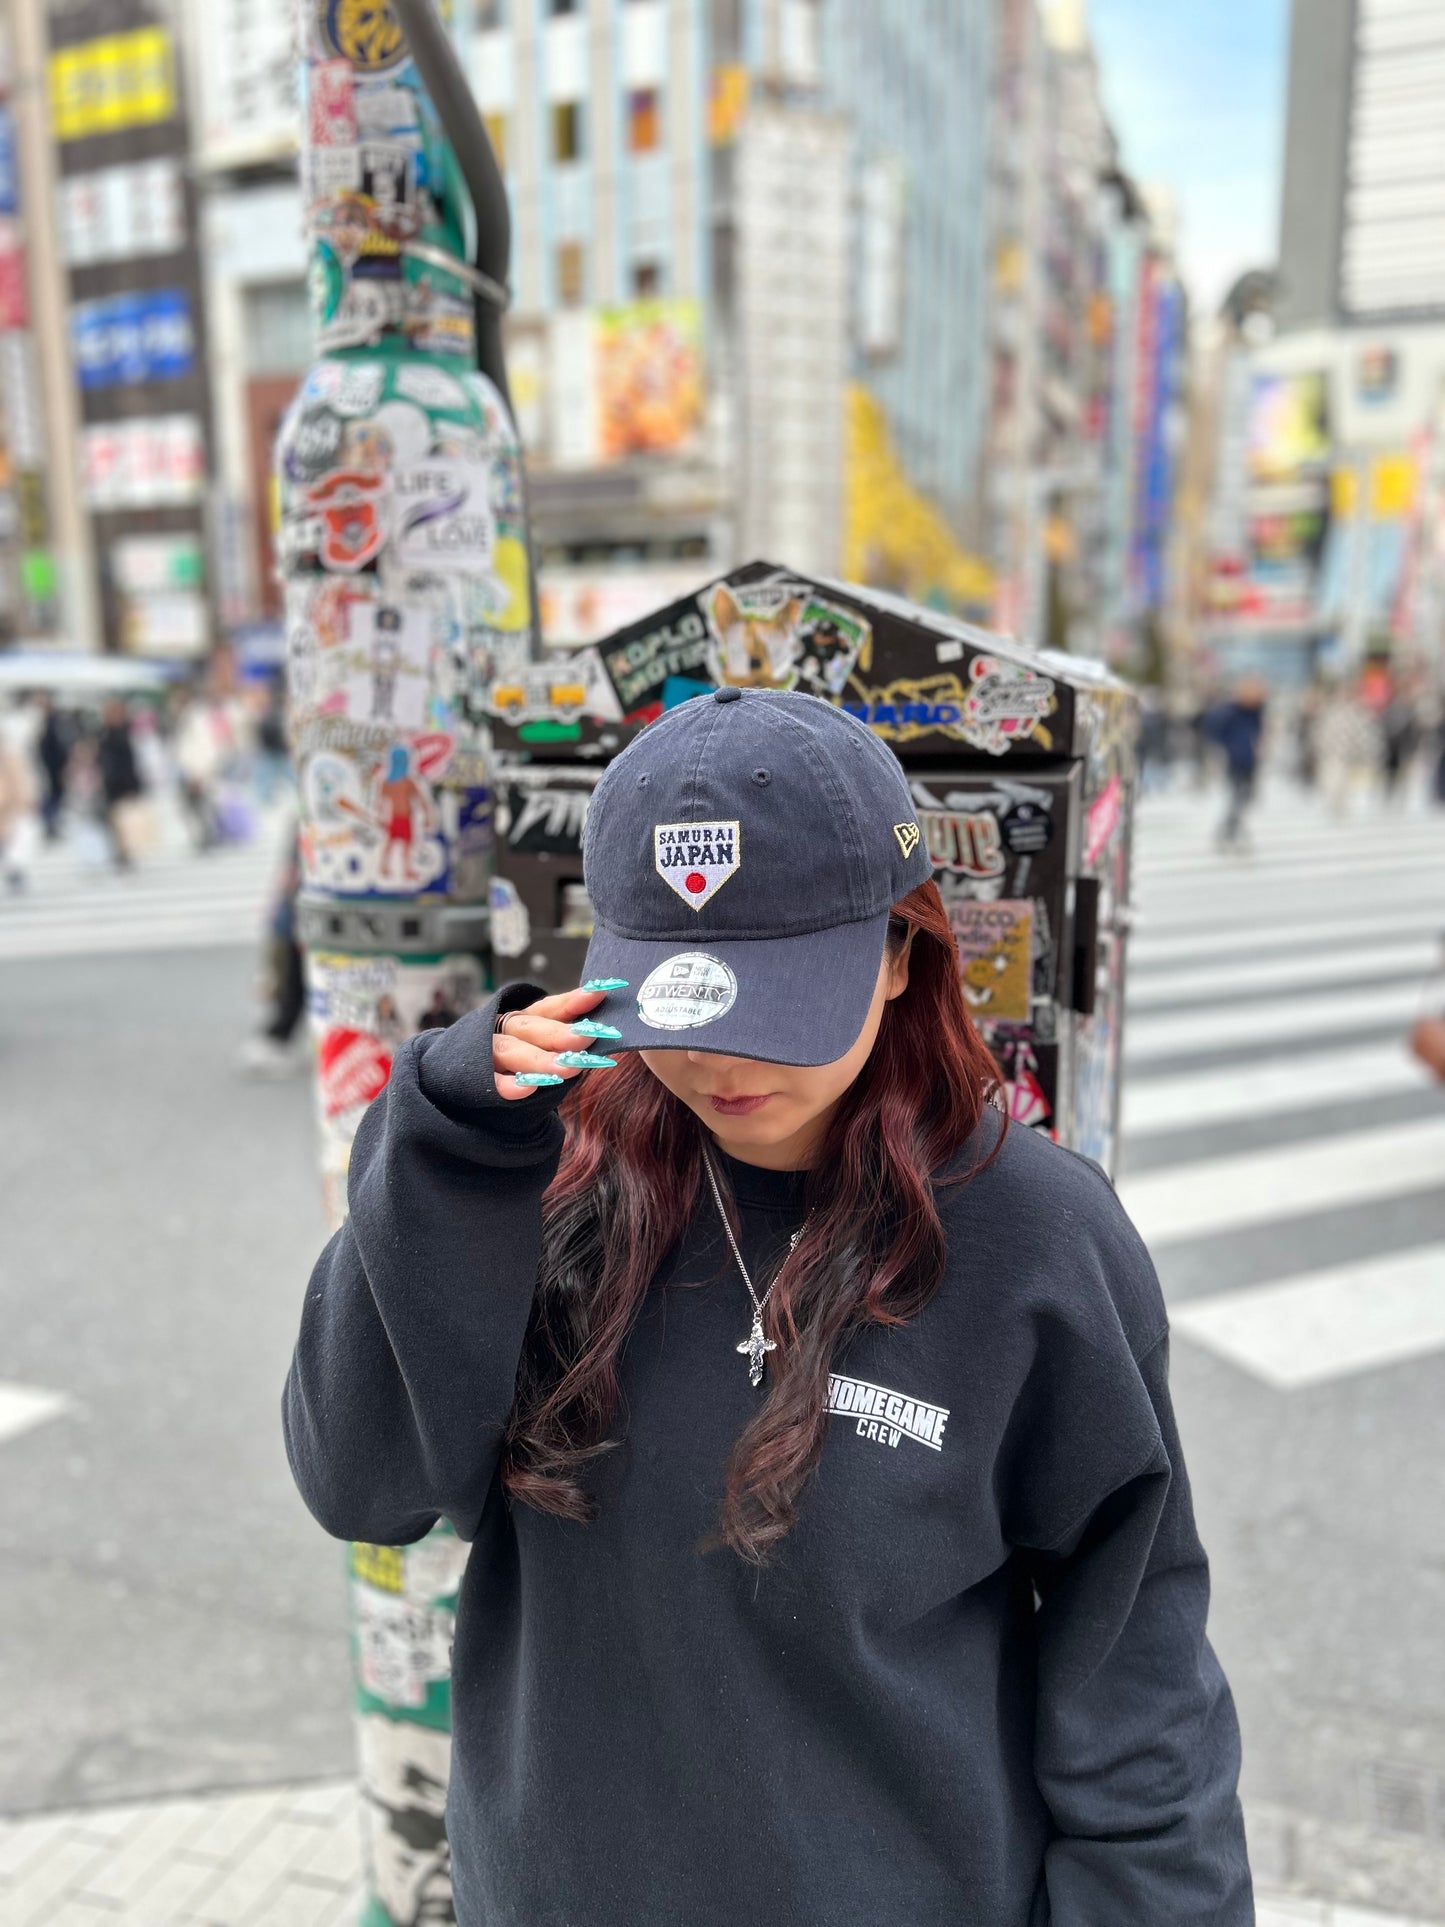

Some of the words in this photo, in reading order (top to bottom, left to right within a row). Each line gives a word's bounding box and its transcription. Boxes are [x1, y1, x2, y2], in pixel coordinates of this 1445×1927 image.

[660, 828, 733, 845] SAMURAI
[660, 843, 734, 868] JAPAN
[643, 984, 731, 1001] 9TWENTY
[654, 1006, 703, 1016] ADJUSTABLE
[856, 1418, 902, 1449] CREW
